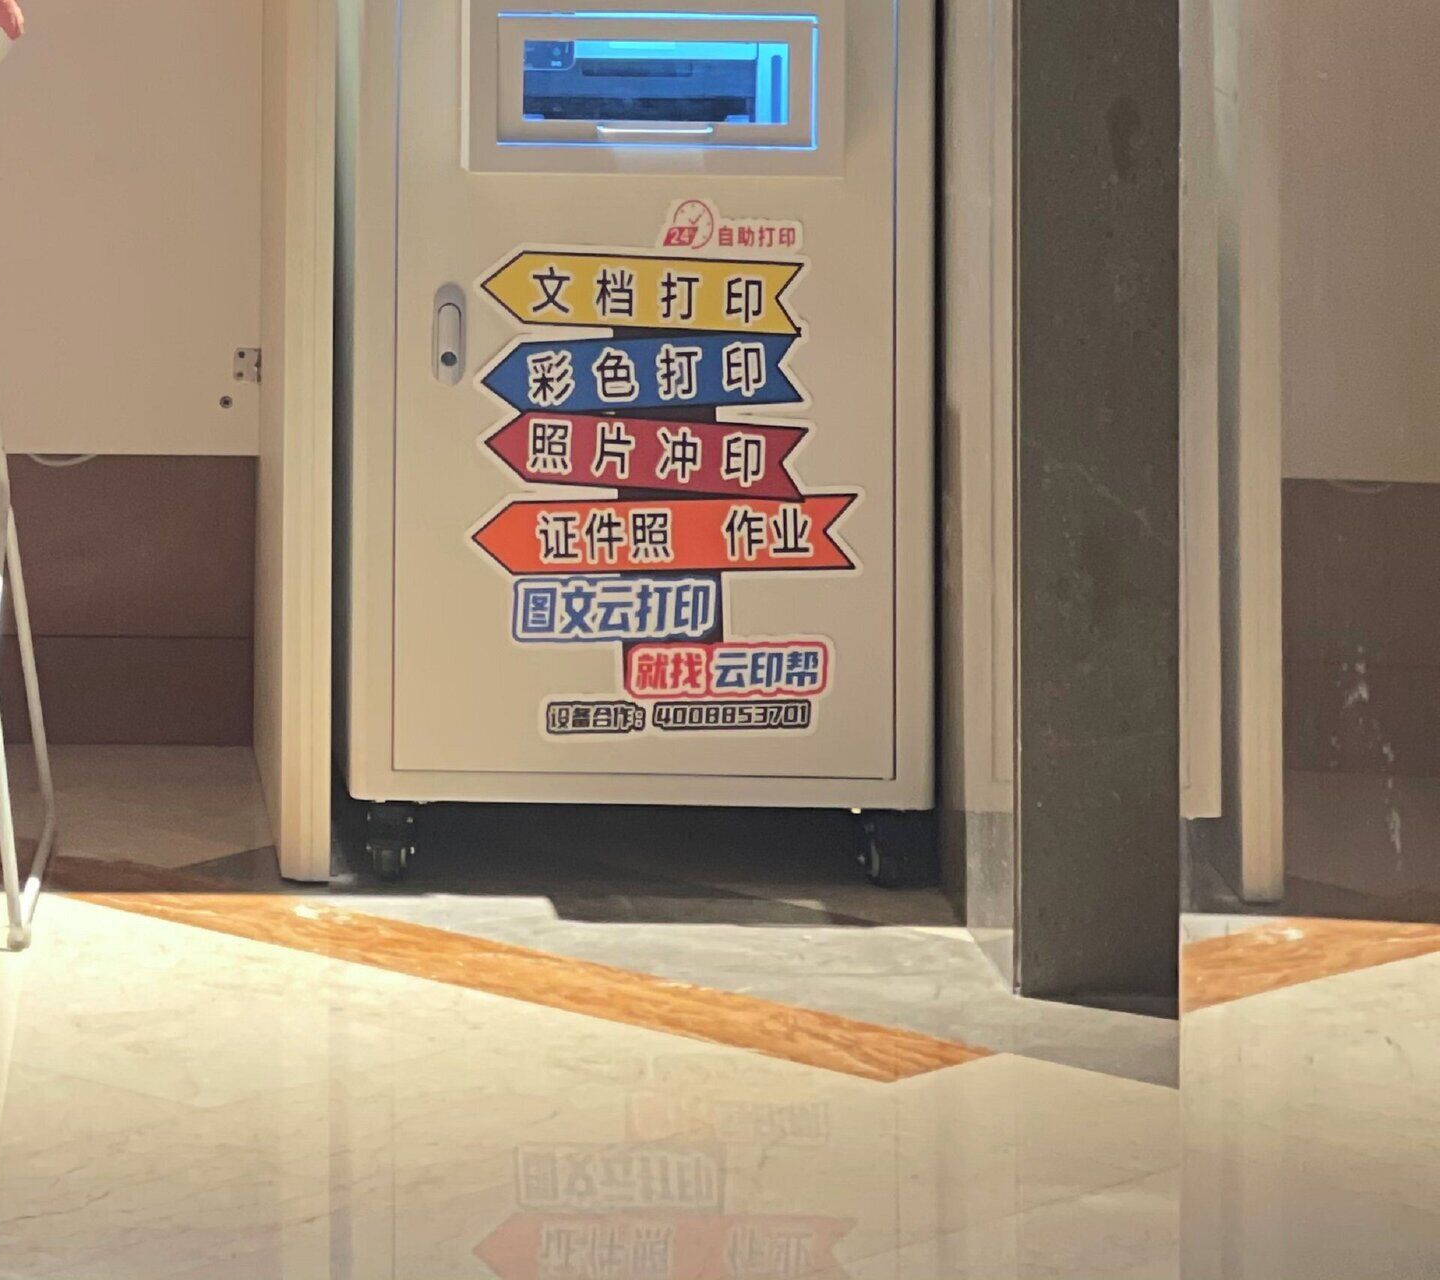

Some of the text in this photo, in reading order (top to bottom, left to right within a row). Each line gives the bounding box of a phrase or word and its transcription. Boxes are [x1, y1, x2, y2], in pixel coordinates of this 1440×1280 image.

[718, 225, 797, 248] 自助打印
[531, 266, 763, 324] 文档打印
[530, 344, 764, 405] 彩色打印
[530, 421, 763, 484] 照片冲印
[538, 507, 811, 561] 证件照 作业
[522, 584, 711, 635] 图文云打印
[655, 704, 809, 728] 4008853701
